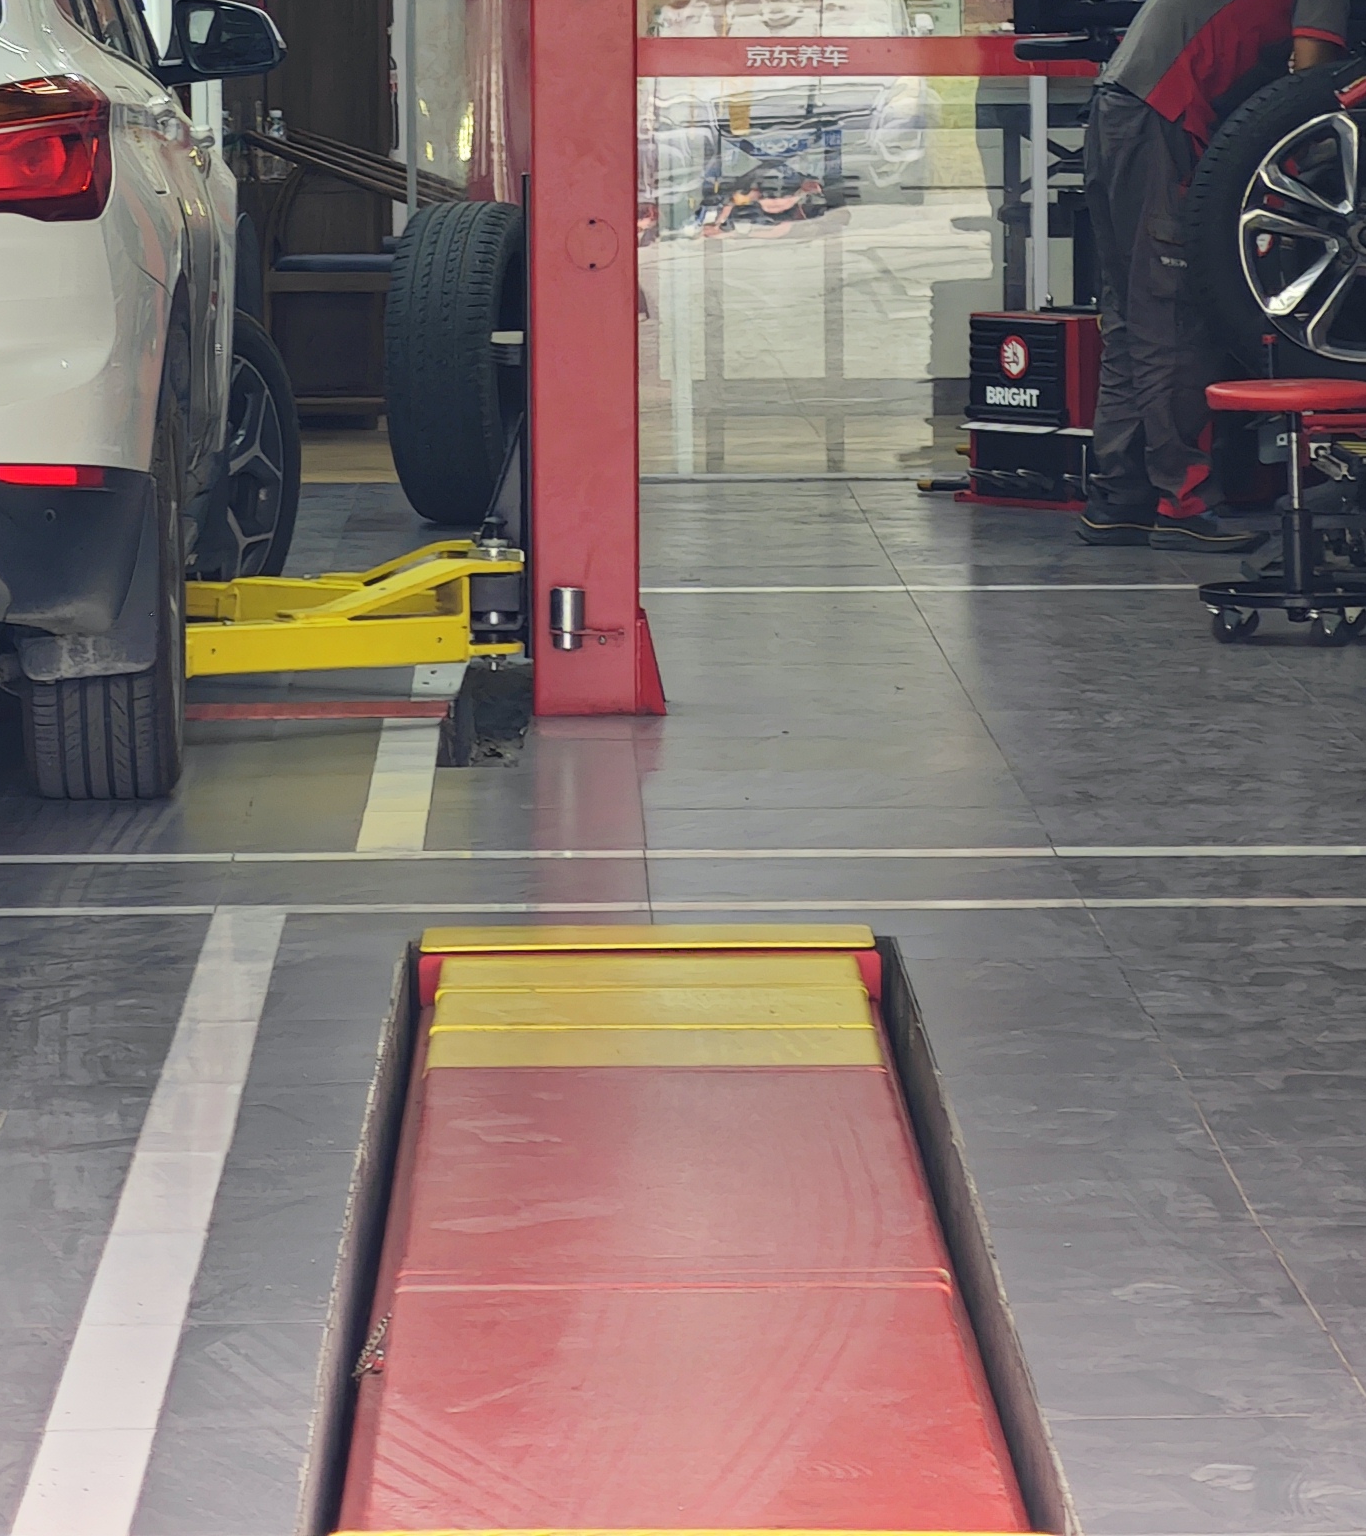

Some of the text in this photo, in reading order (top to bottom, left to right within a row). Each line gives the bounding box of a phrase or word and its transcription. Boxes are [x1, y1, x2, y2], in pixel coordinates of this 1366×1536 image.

[745, 45, 849, 68] 京东养车
[985, 385, 1041, 408] BRIGHT
